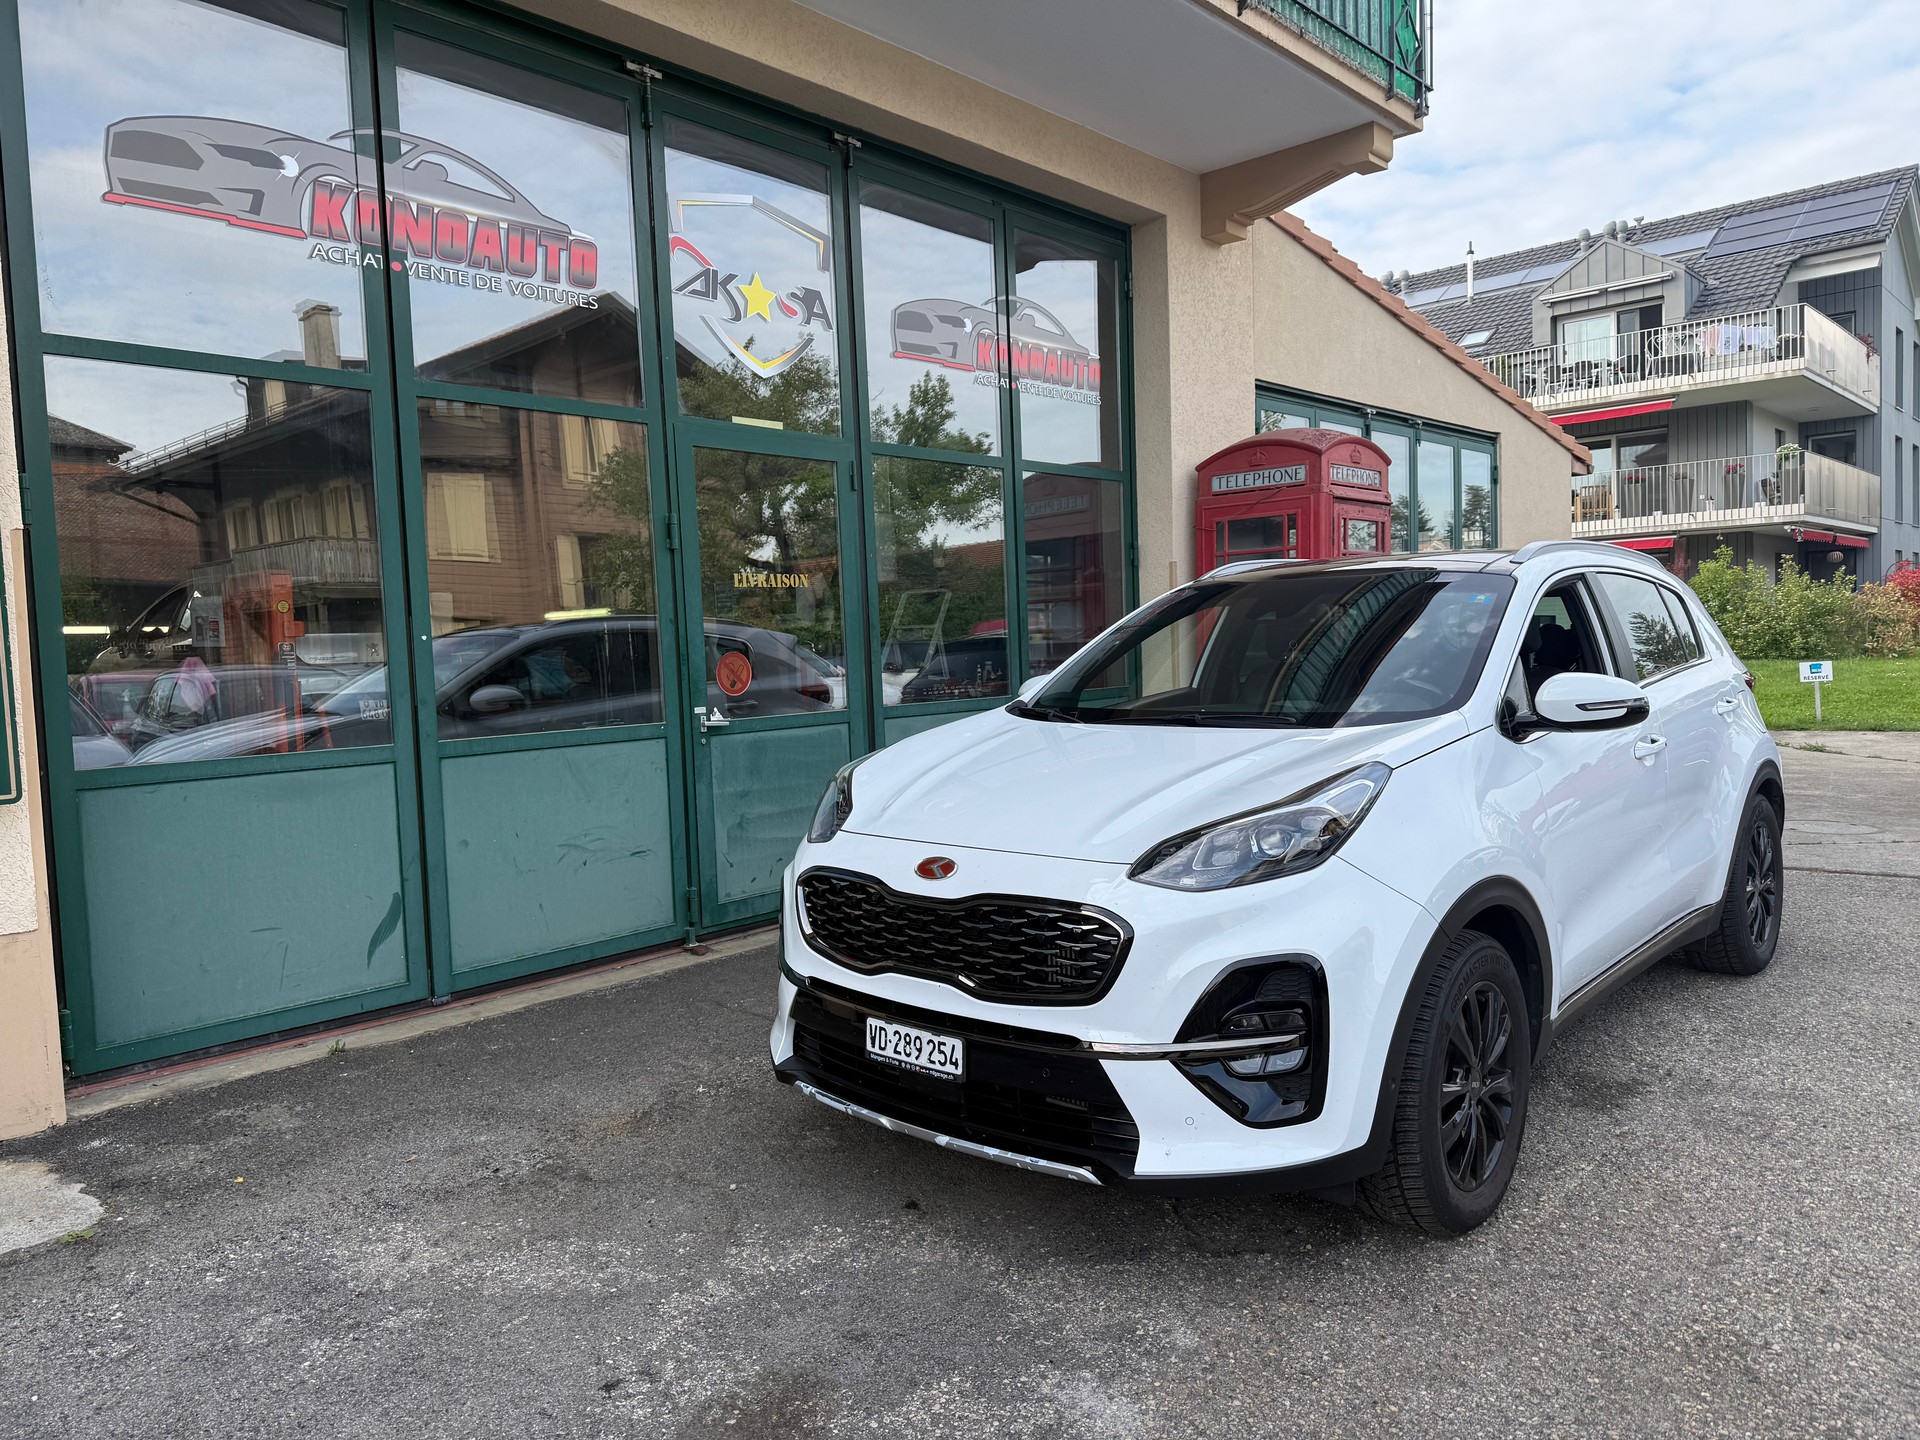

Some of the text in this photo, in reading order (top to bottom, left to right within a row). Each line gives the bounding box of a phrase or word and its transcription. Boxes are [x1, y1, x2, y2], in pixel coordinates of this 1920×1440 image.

[311, 180, 598, 289] KONOAUTO
[311, 243, 599, 310] ACHAT VENTE DE VOITURES
[976, 332, 1101, 392] KONOAUTO
[977, 374, 1102, 406] ACHAT VENTE DE VOITURES
[1216, 466, 1303, 489] TELEPHONE
[1330, 465, 1380, 487] TELEPHONE
[733, 573, 809, 588] LIVRAISON
